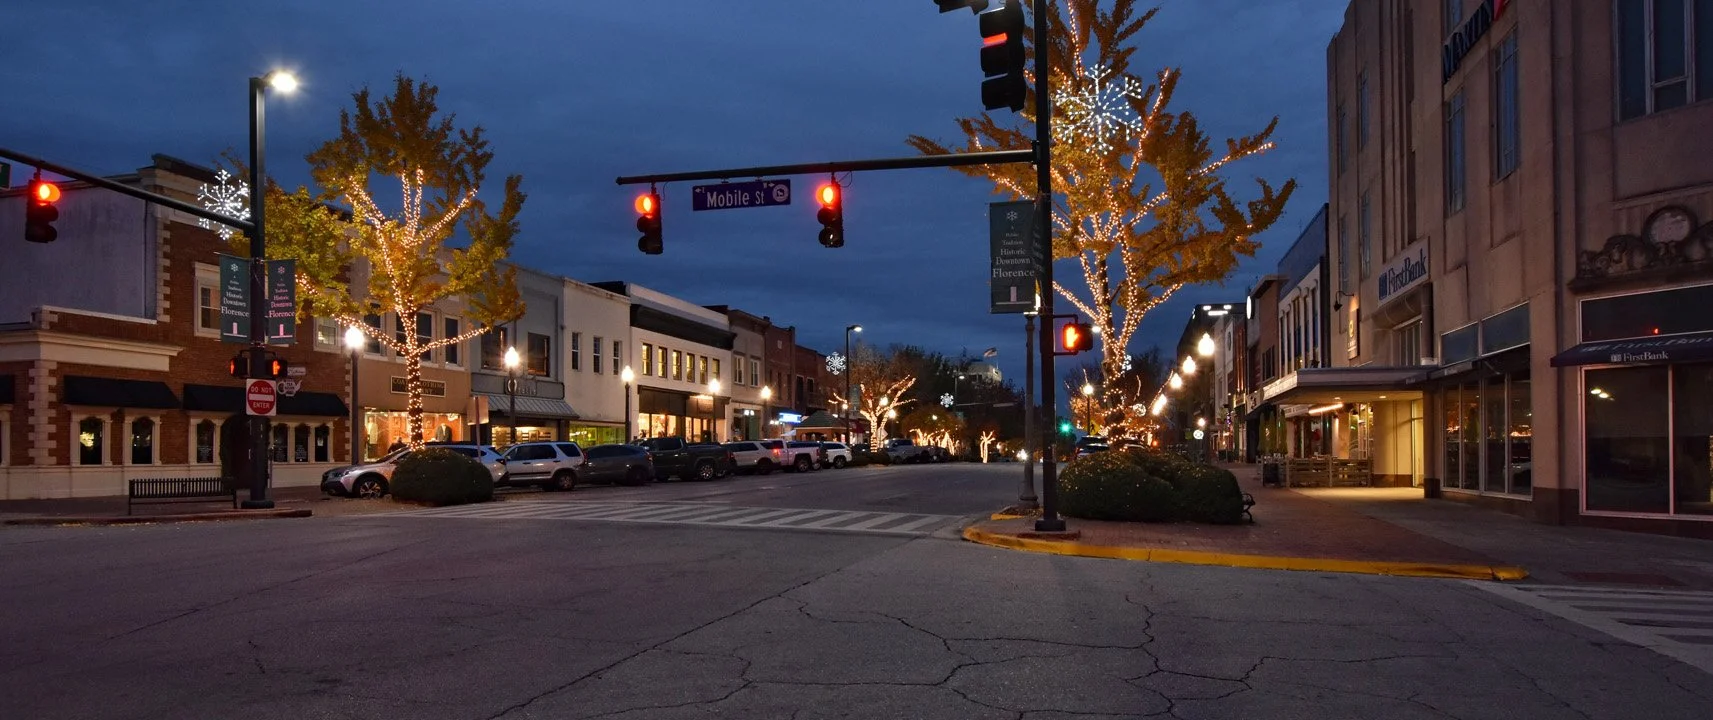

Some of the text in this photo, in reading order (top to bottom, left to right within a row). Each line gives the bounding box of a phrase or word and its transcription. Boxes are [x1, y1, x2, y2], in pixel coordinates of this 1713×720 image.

[706, 190, 750, 208] Mobile
[755, 190, 765, 205] St
[1000, 248, 1026, 256] Historic
[996, 256, 1031, 265] Downtown
[992, 268, 1035, 278] Florence
[1388, 248, 1427, 295] FirstBank
[226, 291, 243, 299] Historic
[223, 297, 246, 307] Downtown
[221, 306, 250, 317] Florence
[268, 310, 295, 318] Florence
[1623, 350, 1669, 362] FirstBank
